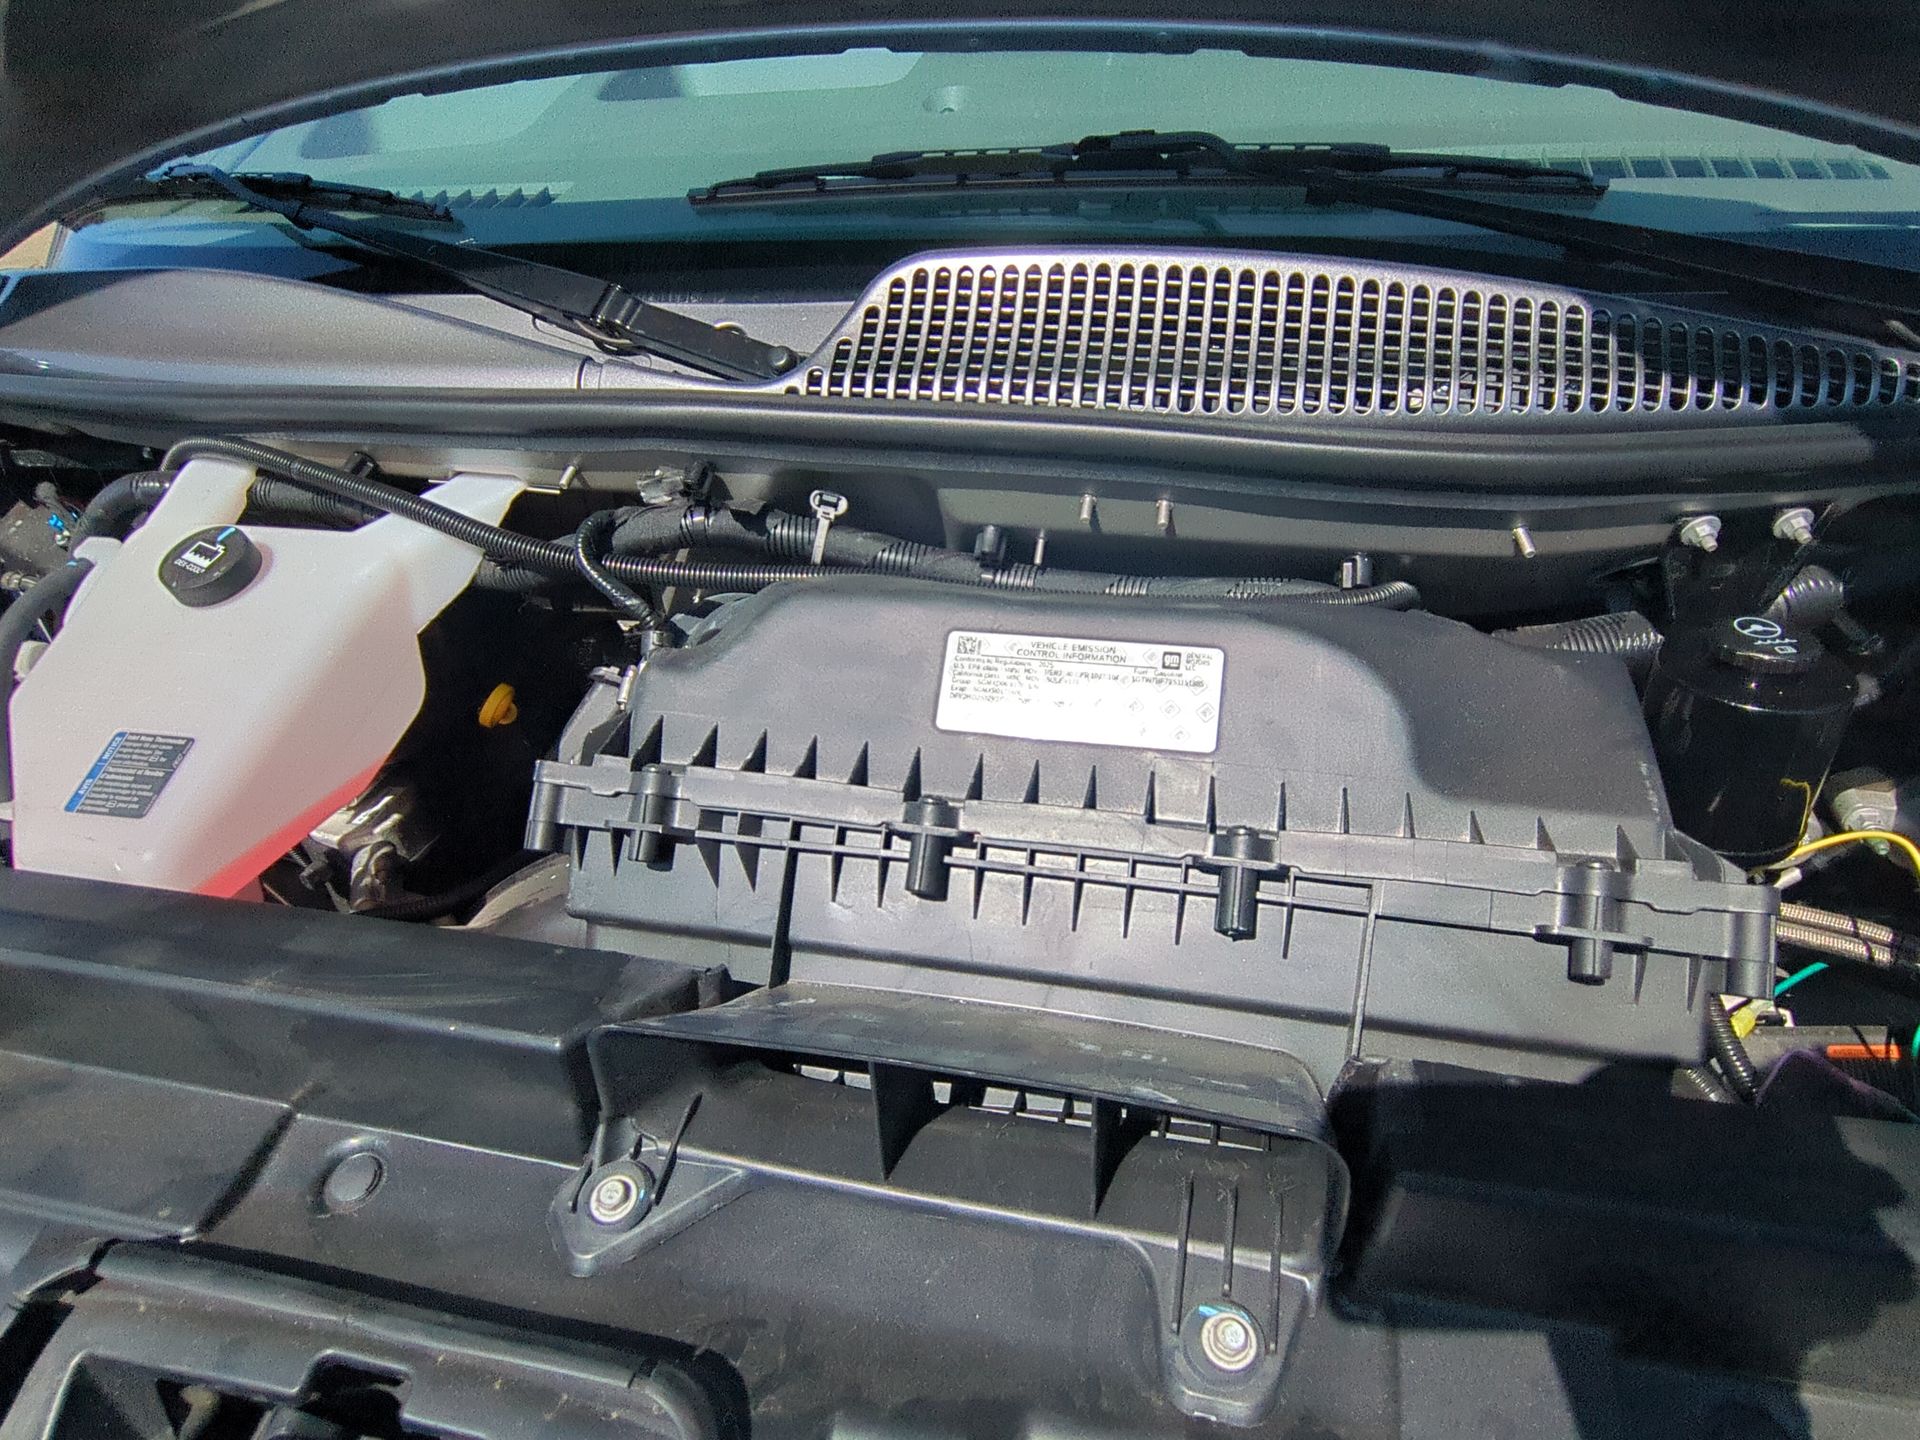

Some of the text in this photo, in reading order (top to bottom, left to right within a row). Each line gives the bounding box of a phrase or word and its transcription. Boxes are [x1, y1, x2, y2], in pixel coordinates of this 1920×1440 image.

[1031, 641, 1117, 654] VEHICLE EMISSION
[1016, 648, 1127, 663] CONTROL INFORMATION
